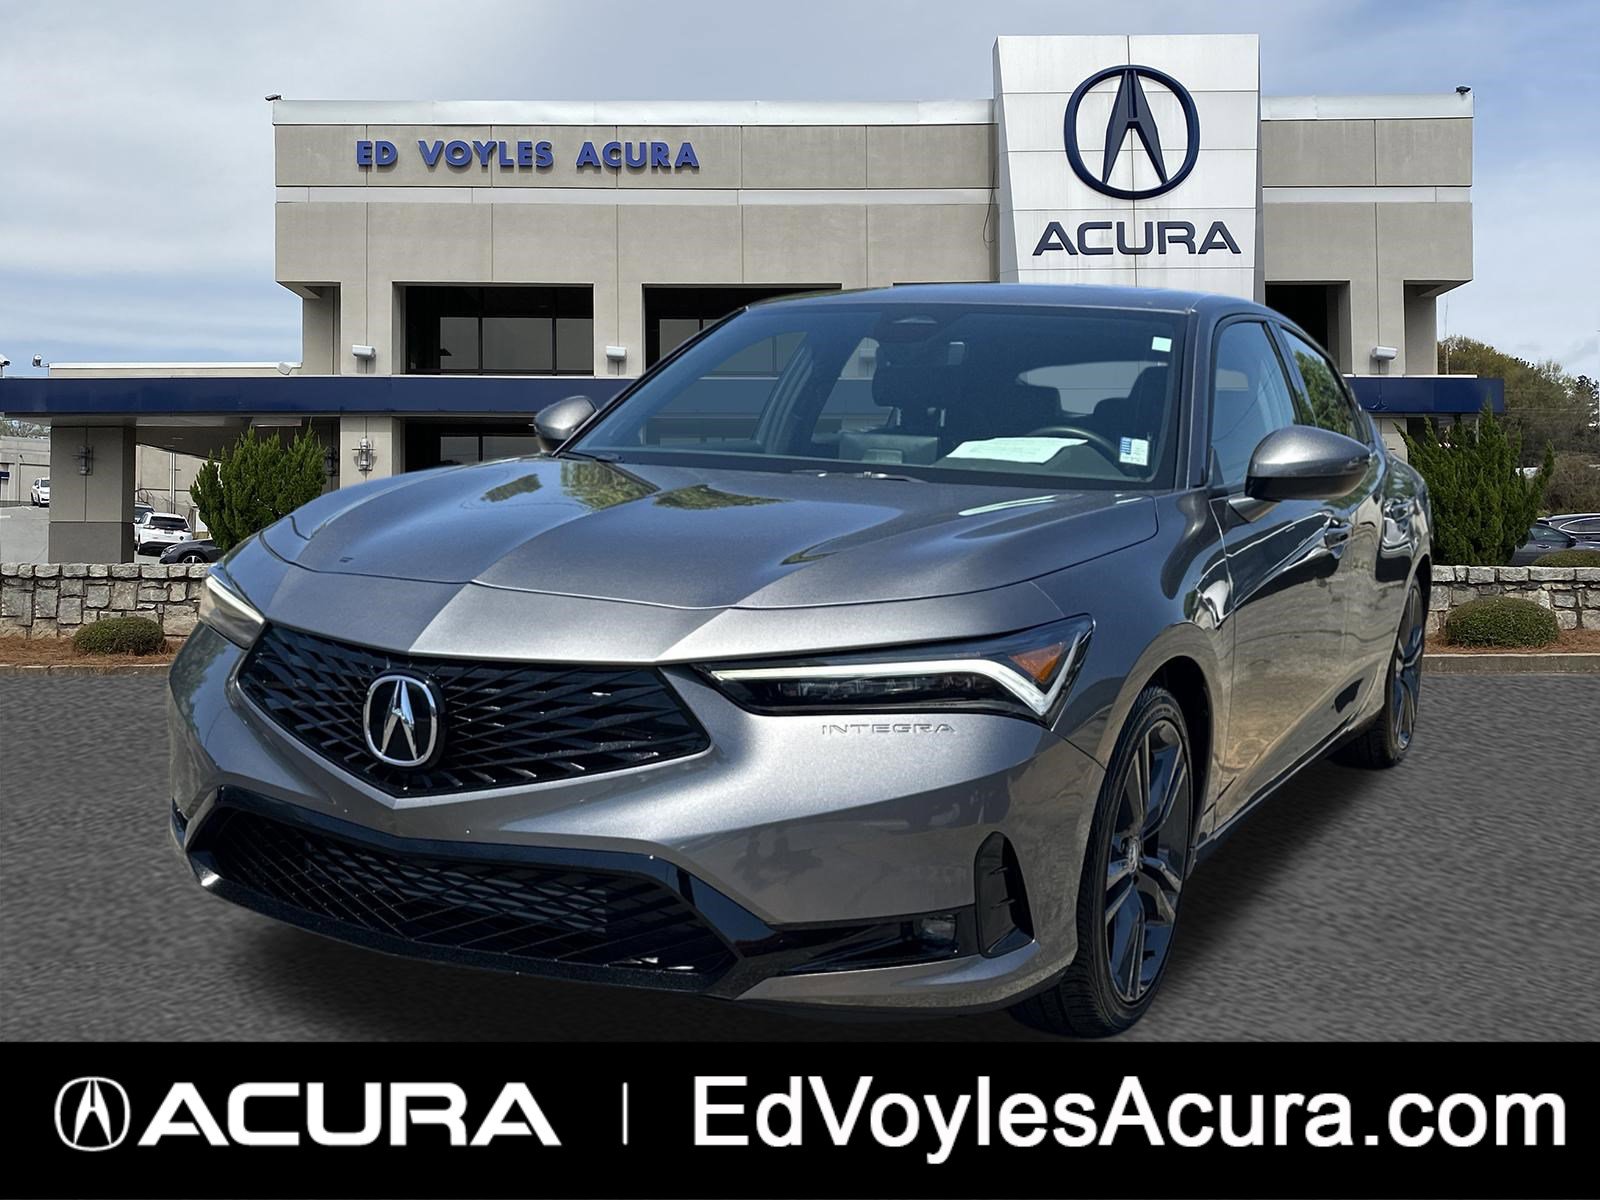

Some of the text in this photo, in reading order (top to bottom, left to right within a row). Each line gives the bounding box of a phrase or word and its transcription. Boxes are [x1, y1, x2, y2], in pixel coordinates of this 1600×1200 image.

[356, 139, 700, 169] ED VOYLES ACURA
[1032, 220, 1242, 256] ACURA
[822, 723, 956, 735] INTEGRA
